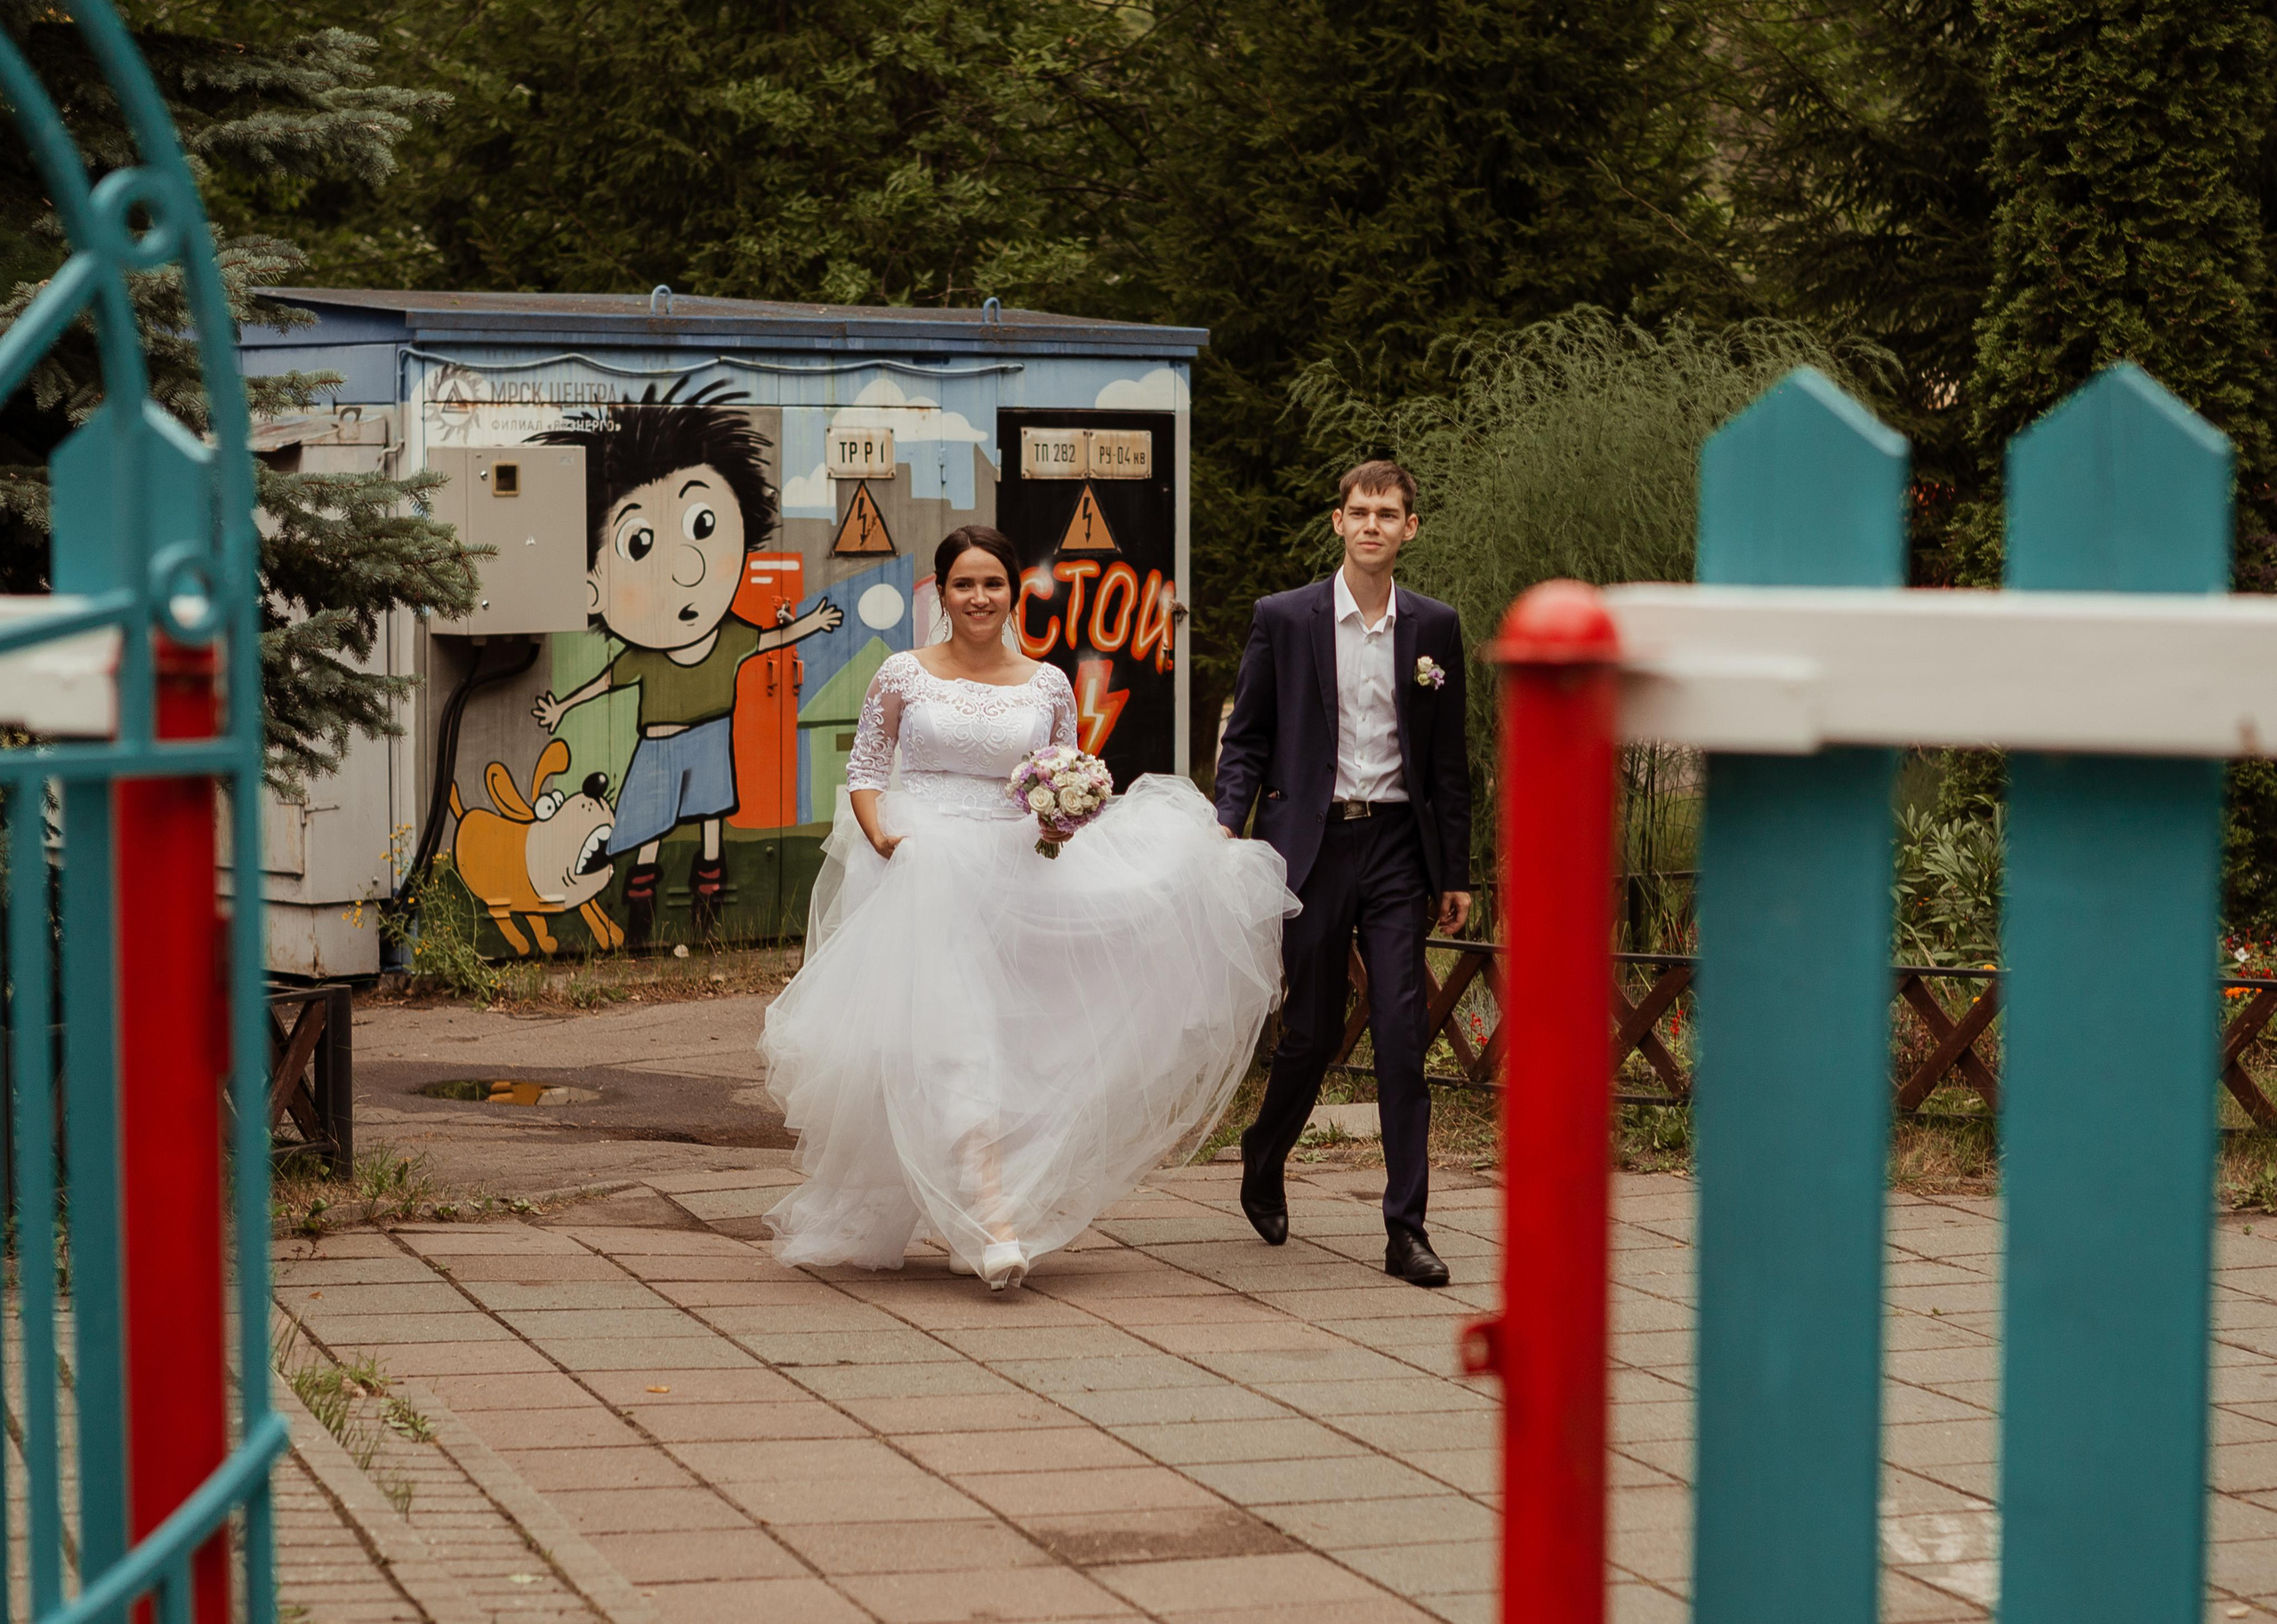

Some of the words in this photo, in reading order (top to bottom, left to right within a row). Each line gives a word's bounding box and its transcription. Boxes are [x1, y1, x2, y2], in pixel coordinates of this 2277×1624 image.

[491, 381, 543, 407] МРСК
[550, 382, 616, 408] ЦЕНТРА
[491, 420, 543, 431] ФИЛИАЛ
[1034, 443, 1049, 462] ТП
[1053, 443, 1076, 463] 282
